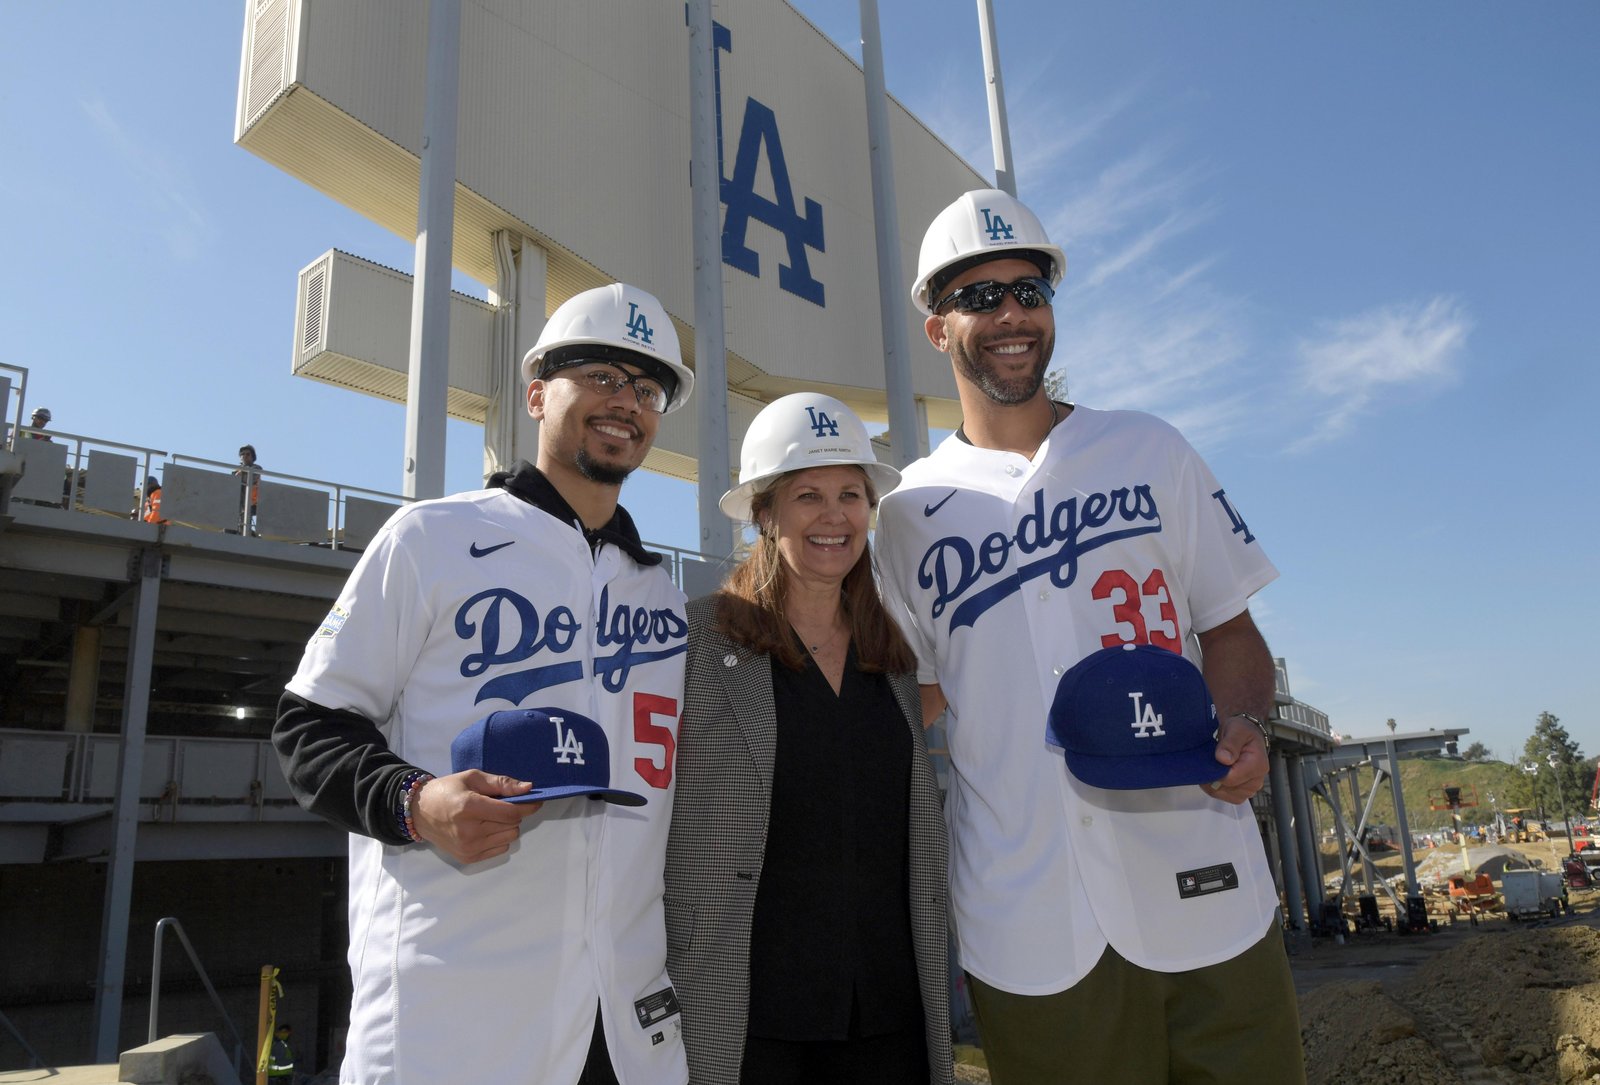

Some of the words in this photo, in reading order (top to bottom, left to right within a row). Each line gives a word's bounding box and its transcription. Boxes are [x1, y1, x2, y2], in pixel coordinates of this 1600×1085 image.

[980, 208, 1014, 241] LA
[625, 301, 654, 344] LA
[804, 406, 840, 438] LA
[918, 484, 1161, 620] Dodgers
[1091, 568, 1182, 656] 33
[1128, 692, 1166, 738] LA
[549, 716, 585, 765] LA
[633, 692, 684, 790] 5
